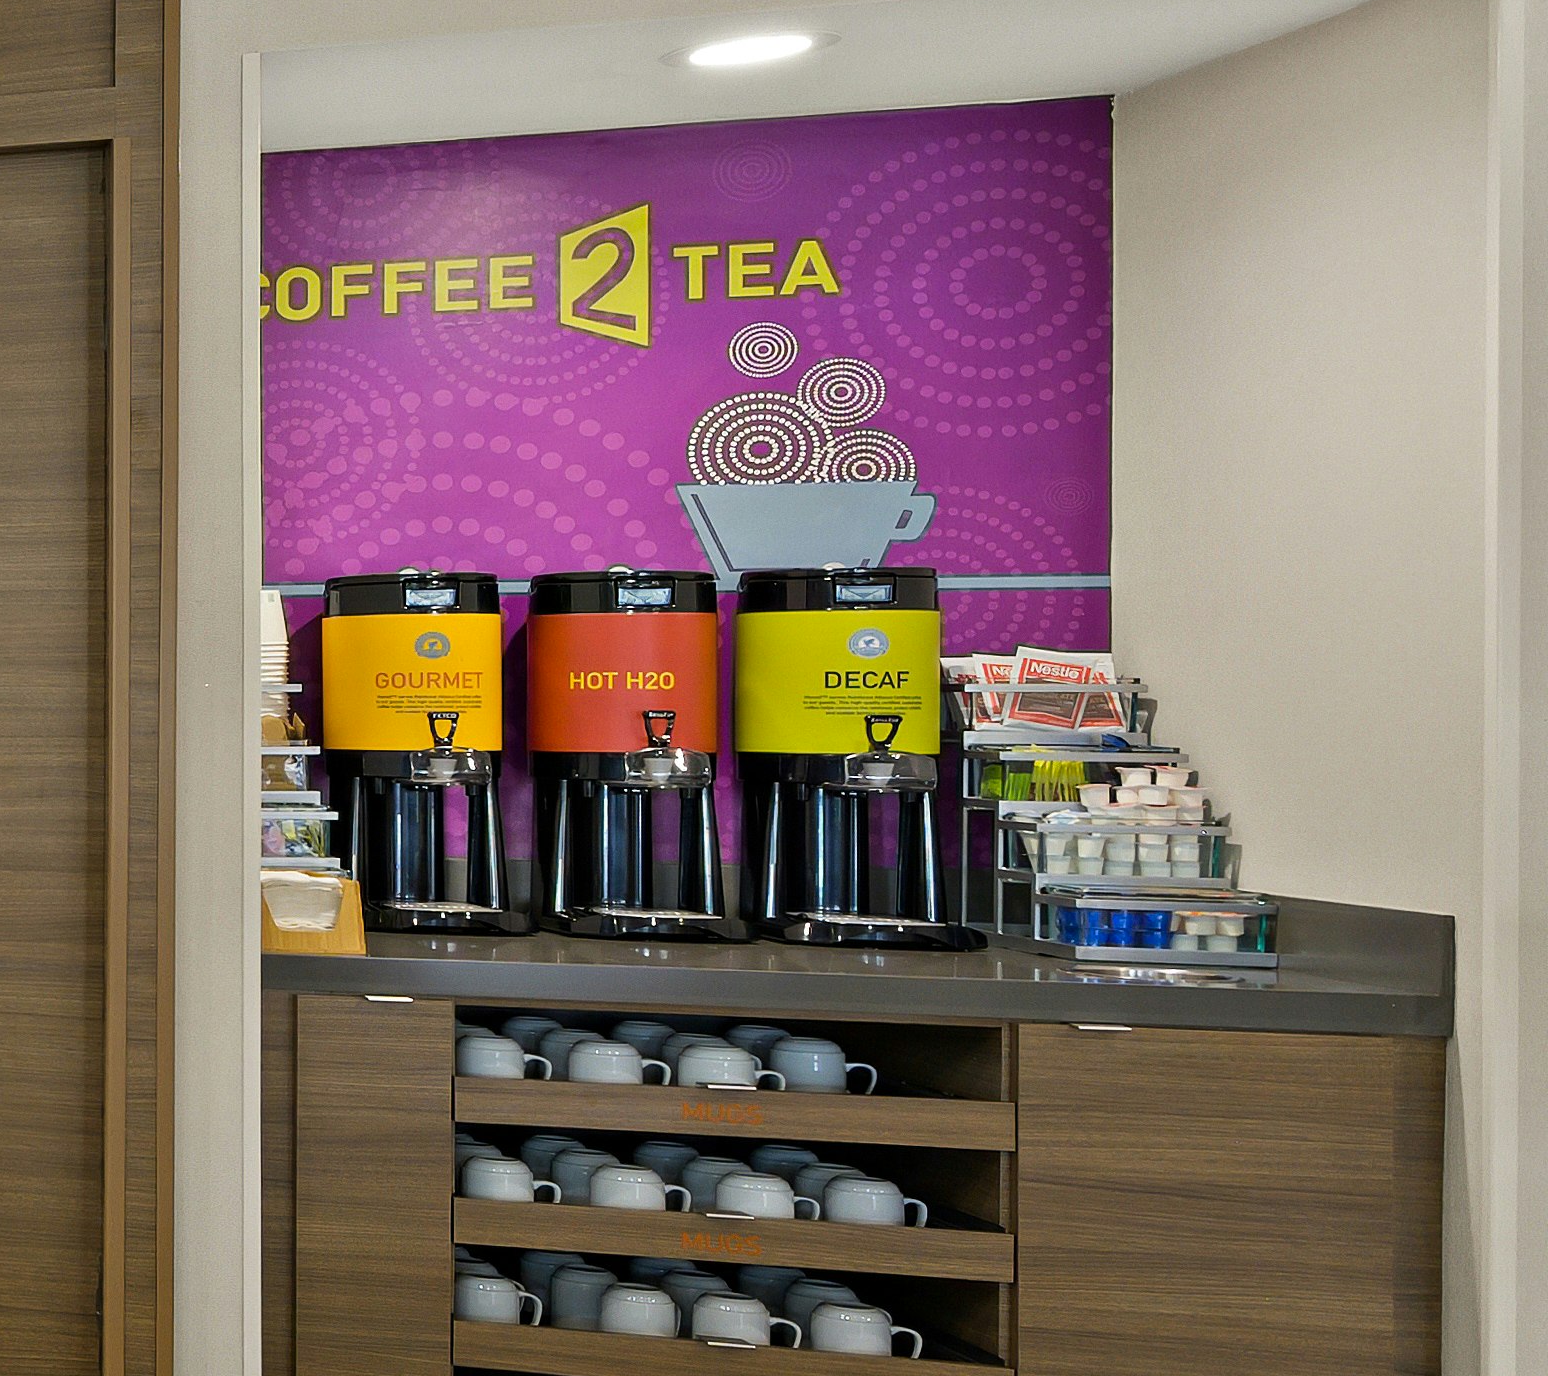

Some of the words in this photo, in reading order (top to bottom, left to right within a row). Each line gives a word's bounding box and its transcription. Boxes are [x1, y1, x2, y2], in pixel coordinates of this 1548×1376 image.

[260, 255, 534, 321] OFFEE
[673, 240, 840, 301] TEA
[375, 671, 483, 689] GOURMET
[569, 671, 619, 690] HOT
[824, 670, 910, 689] DECAF
[682, 1102, 764, 1126] MUGS
[680, 1231, 763, 1256] MUGS
